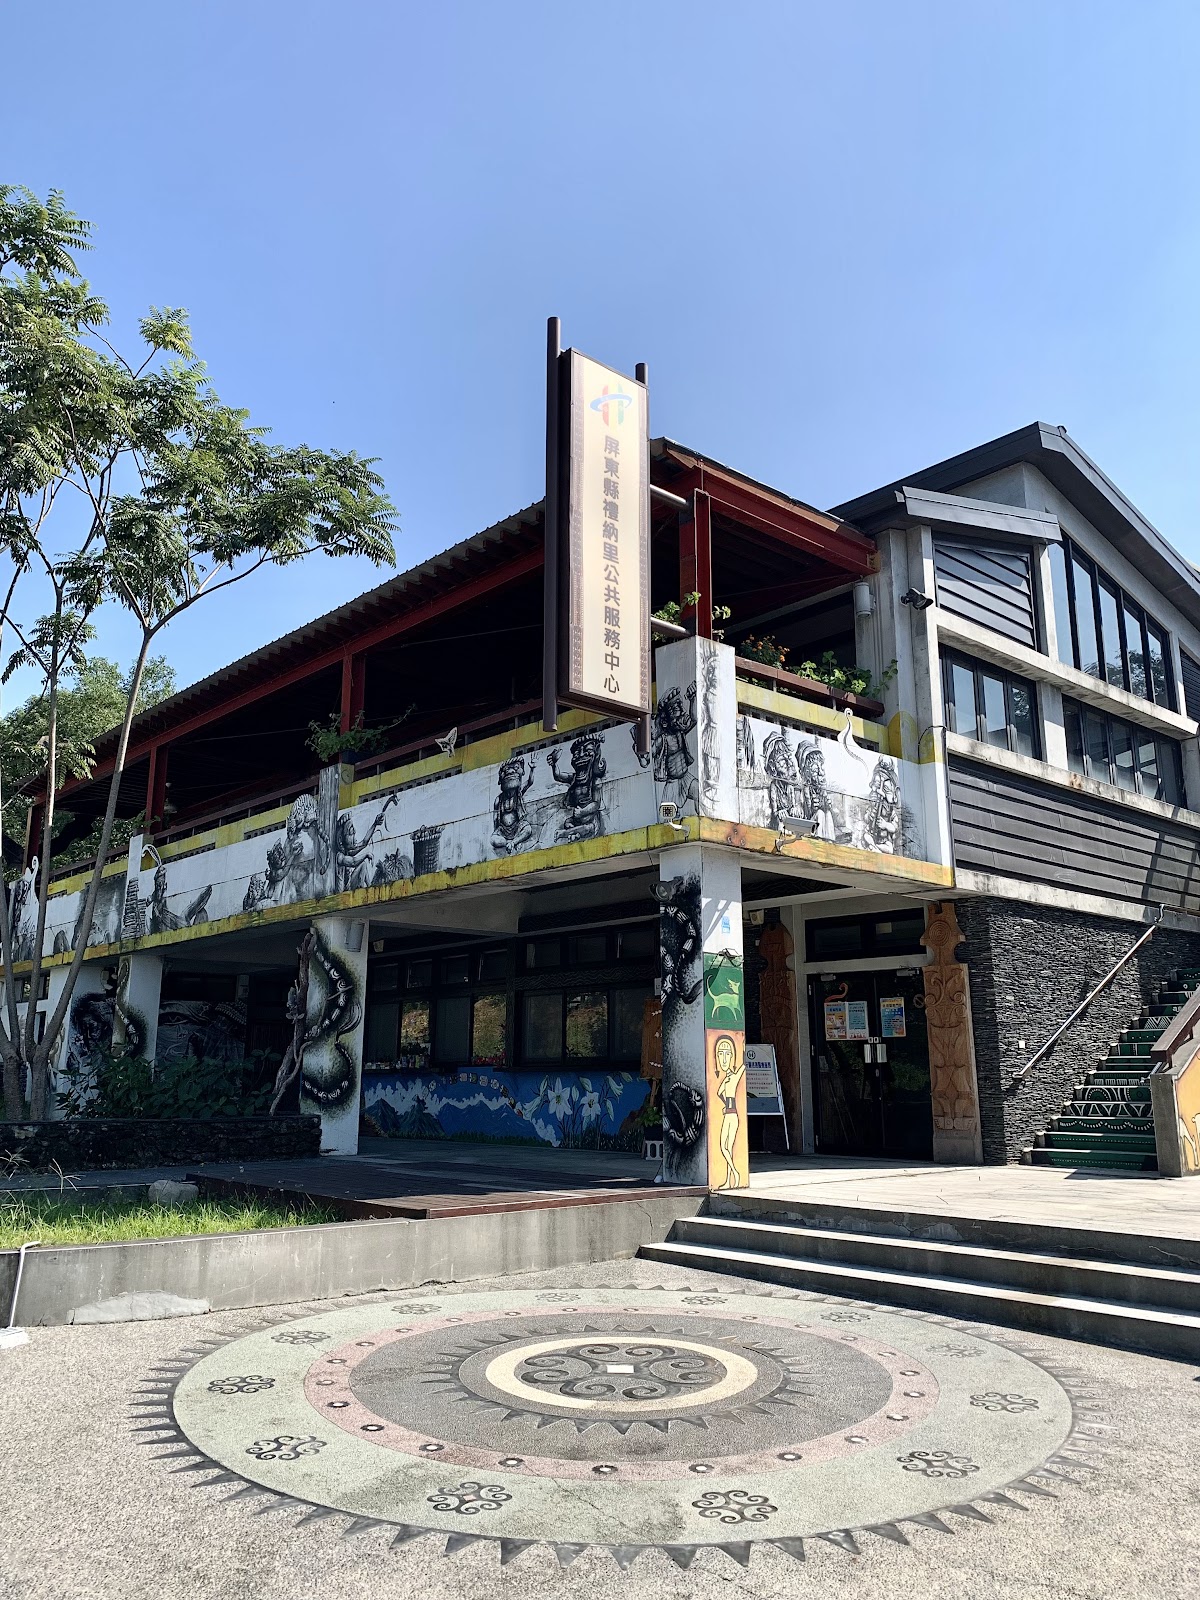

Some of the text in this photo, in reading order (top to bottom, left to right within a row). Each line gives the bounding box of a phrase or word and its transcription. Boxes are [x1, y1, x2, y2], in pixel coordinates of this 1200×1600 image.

[603, 435, 620, 694] 屏東縣禮納里公共服務中心
